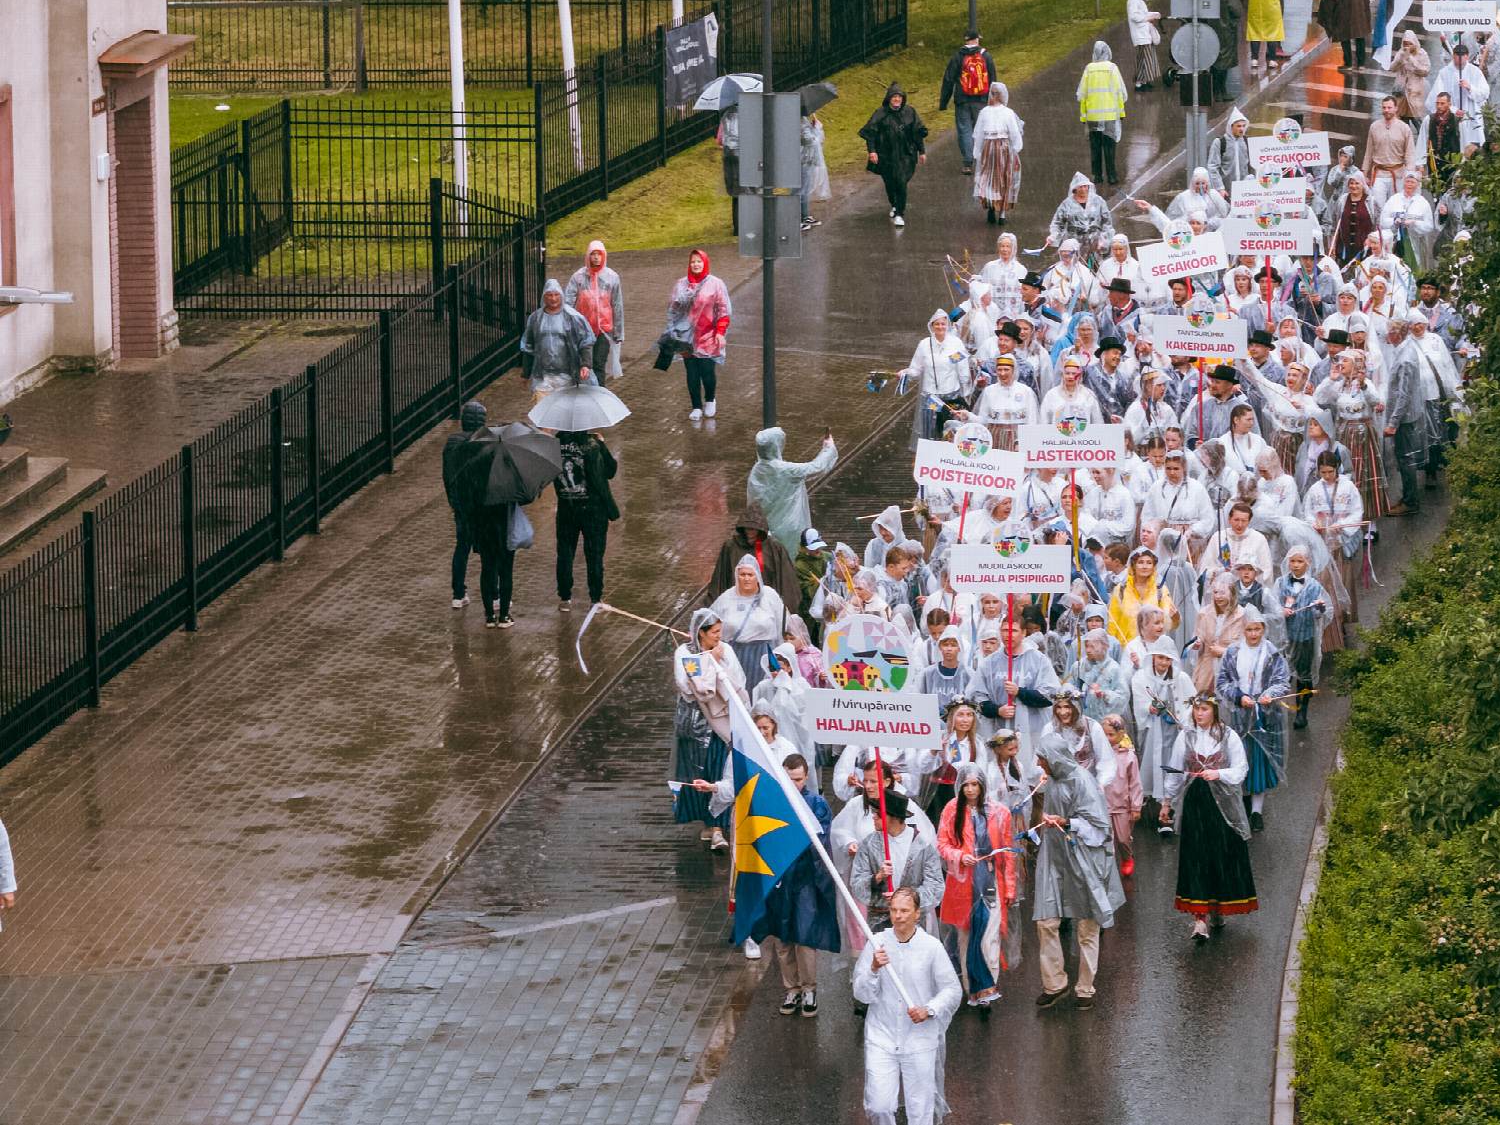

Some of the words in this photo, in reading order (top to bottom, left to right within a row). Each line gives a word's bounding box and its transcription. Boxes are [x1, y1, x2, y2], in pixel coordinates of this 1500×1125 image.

[1428, 17, 1467, 26] KADRINA
[1467, 17, 1491, 26] VALD
[1258, 152, 1321, 165] SEGAKOOR
[1239, 239, 1297, 251] SEGAPIDI
[1151, 254, 1218, 277] SEGAKOOR
[1165, 340, 1235, 353] KAKERDAJAD
[1027, 449, 1116, 462] LASTEKOOR
[939, 457, 975, 469] HALJALA
[975, 463, 1000, 472] KOOLI
[919, 466, 1017, 491] POISTEKOOR
[956, 574, 1006, 584] HALJALA
[1007, 574, 1065, 584] PISIPIIGAD
[815, 717, 888, 735] HALJALA
[889, 721, 931, 736] VALD
